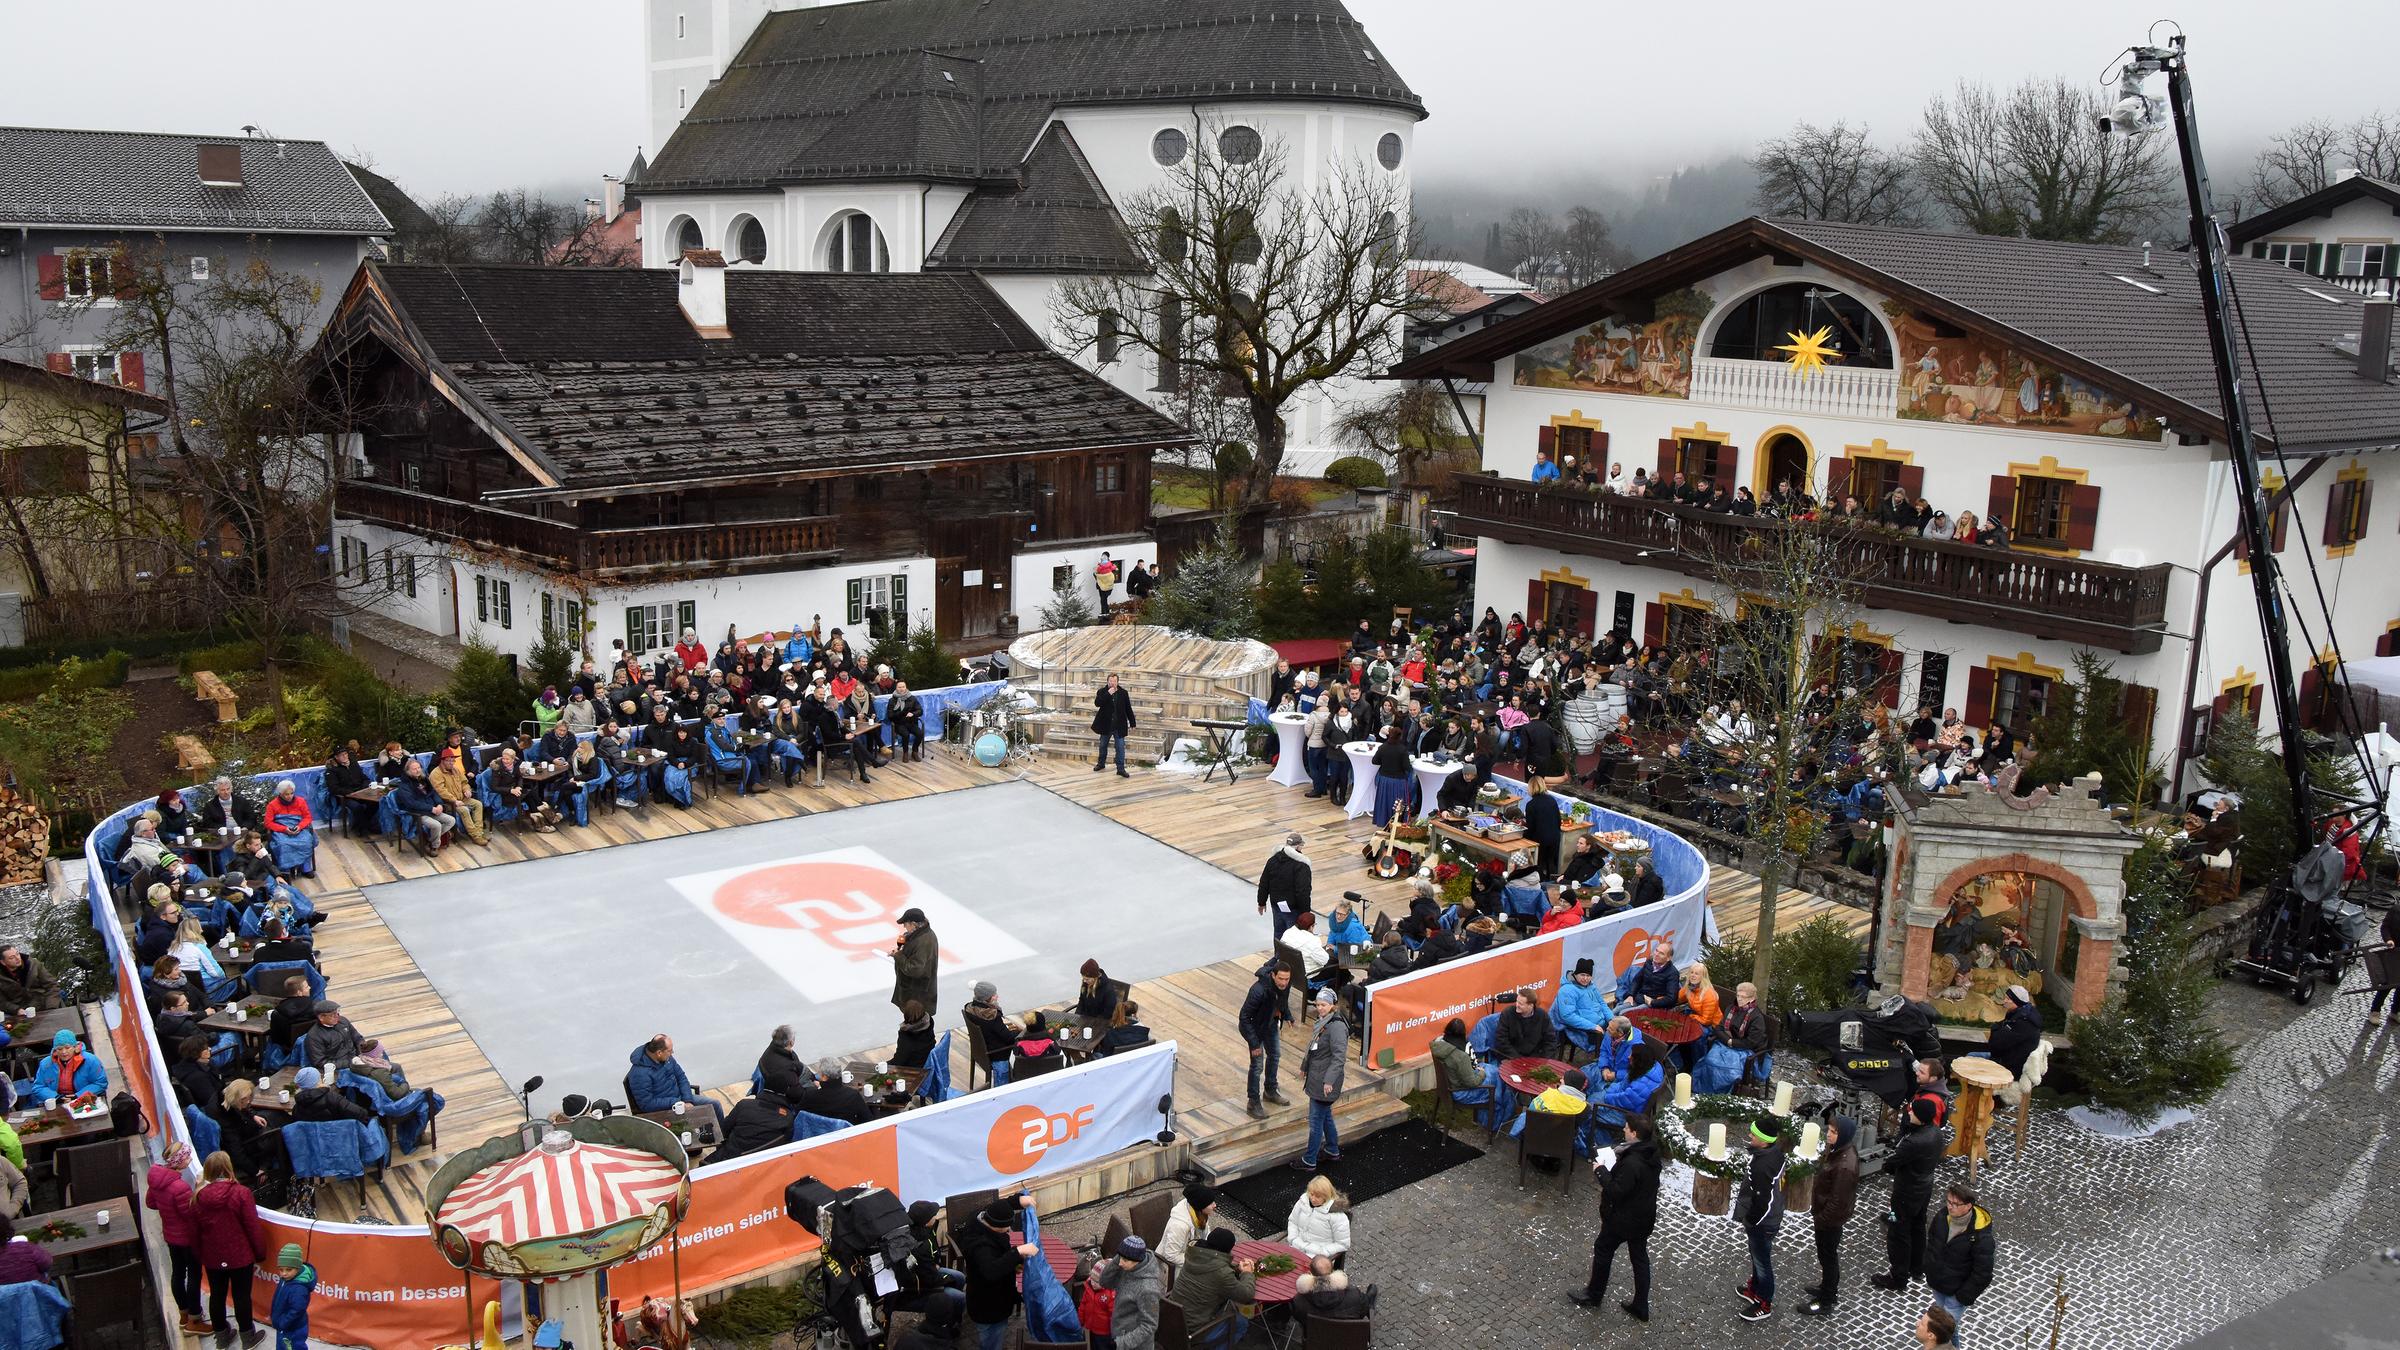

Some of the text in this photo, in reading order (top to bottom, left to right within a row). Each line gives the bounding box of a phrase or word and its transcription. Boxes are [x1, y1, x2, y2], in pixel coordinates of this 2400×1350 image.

[1386, 1021, 1403, 1034] Mit
[1405, 1016, 1427, 1029] dem
[1429, 1003, 1467, 1022] Zweiten
[739, 1206, 779, 1230] sieht
[314, 1280, 467, 1302] sieht man besser
